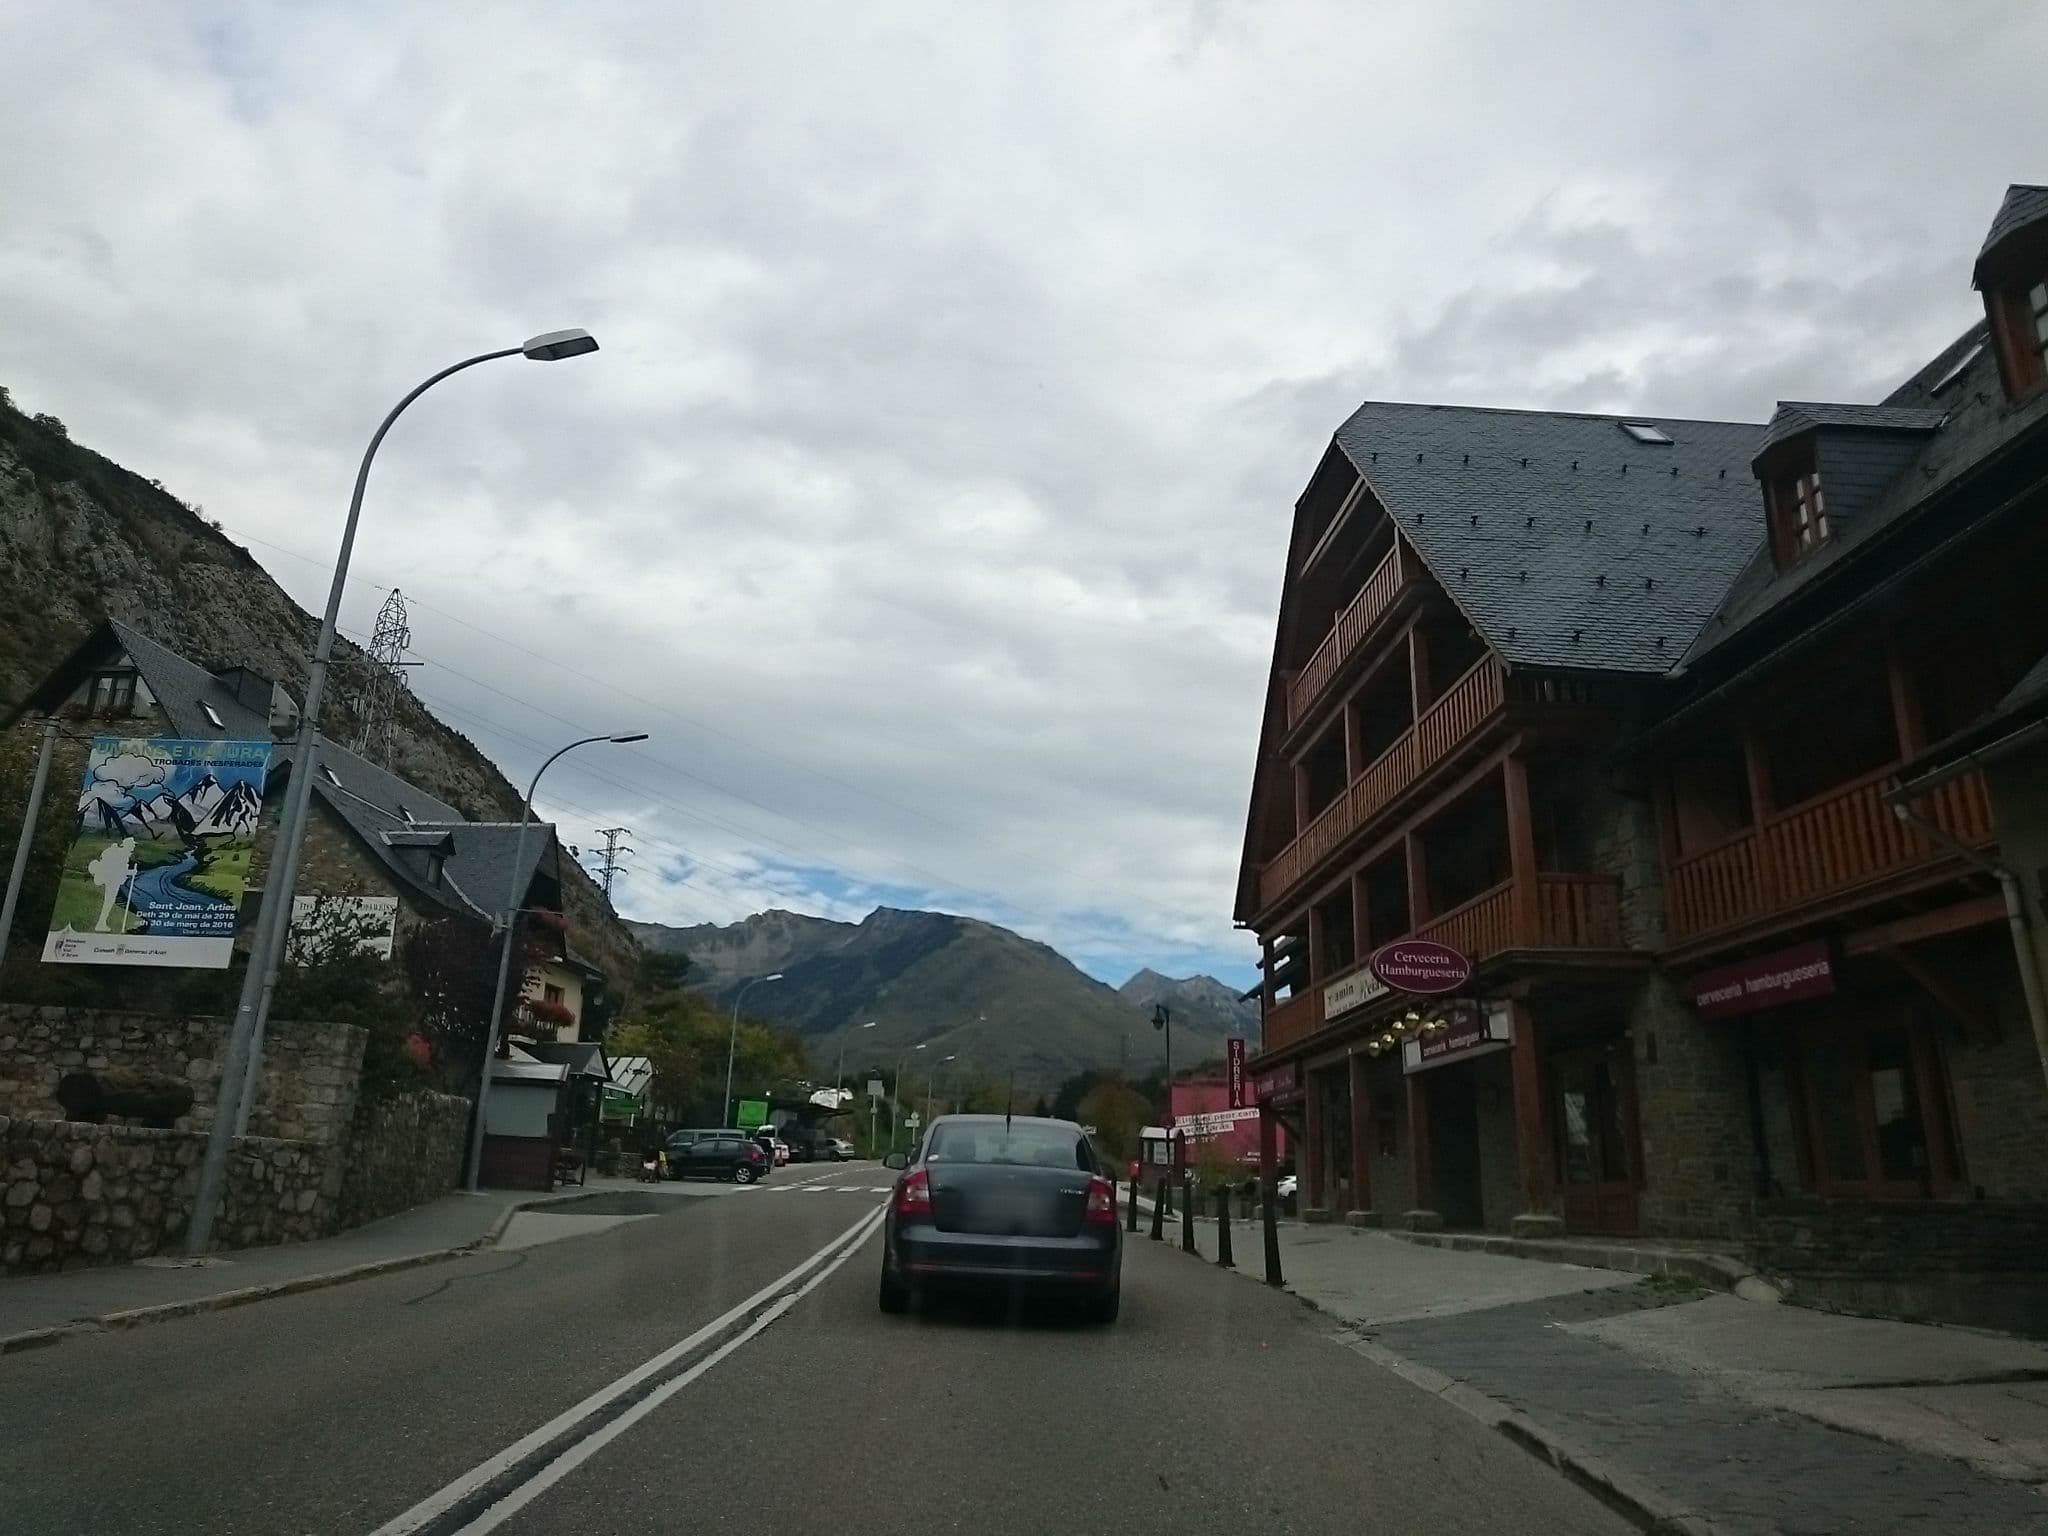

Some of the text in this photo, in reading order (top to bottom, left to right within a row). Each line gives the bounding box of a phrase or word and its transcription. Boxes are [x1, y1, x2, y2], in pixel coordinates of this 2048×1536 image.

[173, 746, 182, 757] E
[153, 759, 263, 768] TROBADES INESPERADES
[149, 902, 172, 910] Sant
[206, 904, 236, 912] Arties
[1394, 951, 1449, 964] Cerveceria
[1380, 964, 1466, 979] Hamburgueseria
[1233, 1041, 1241, 1107] SIDRERIA
